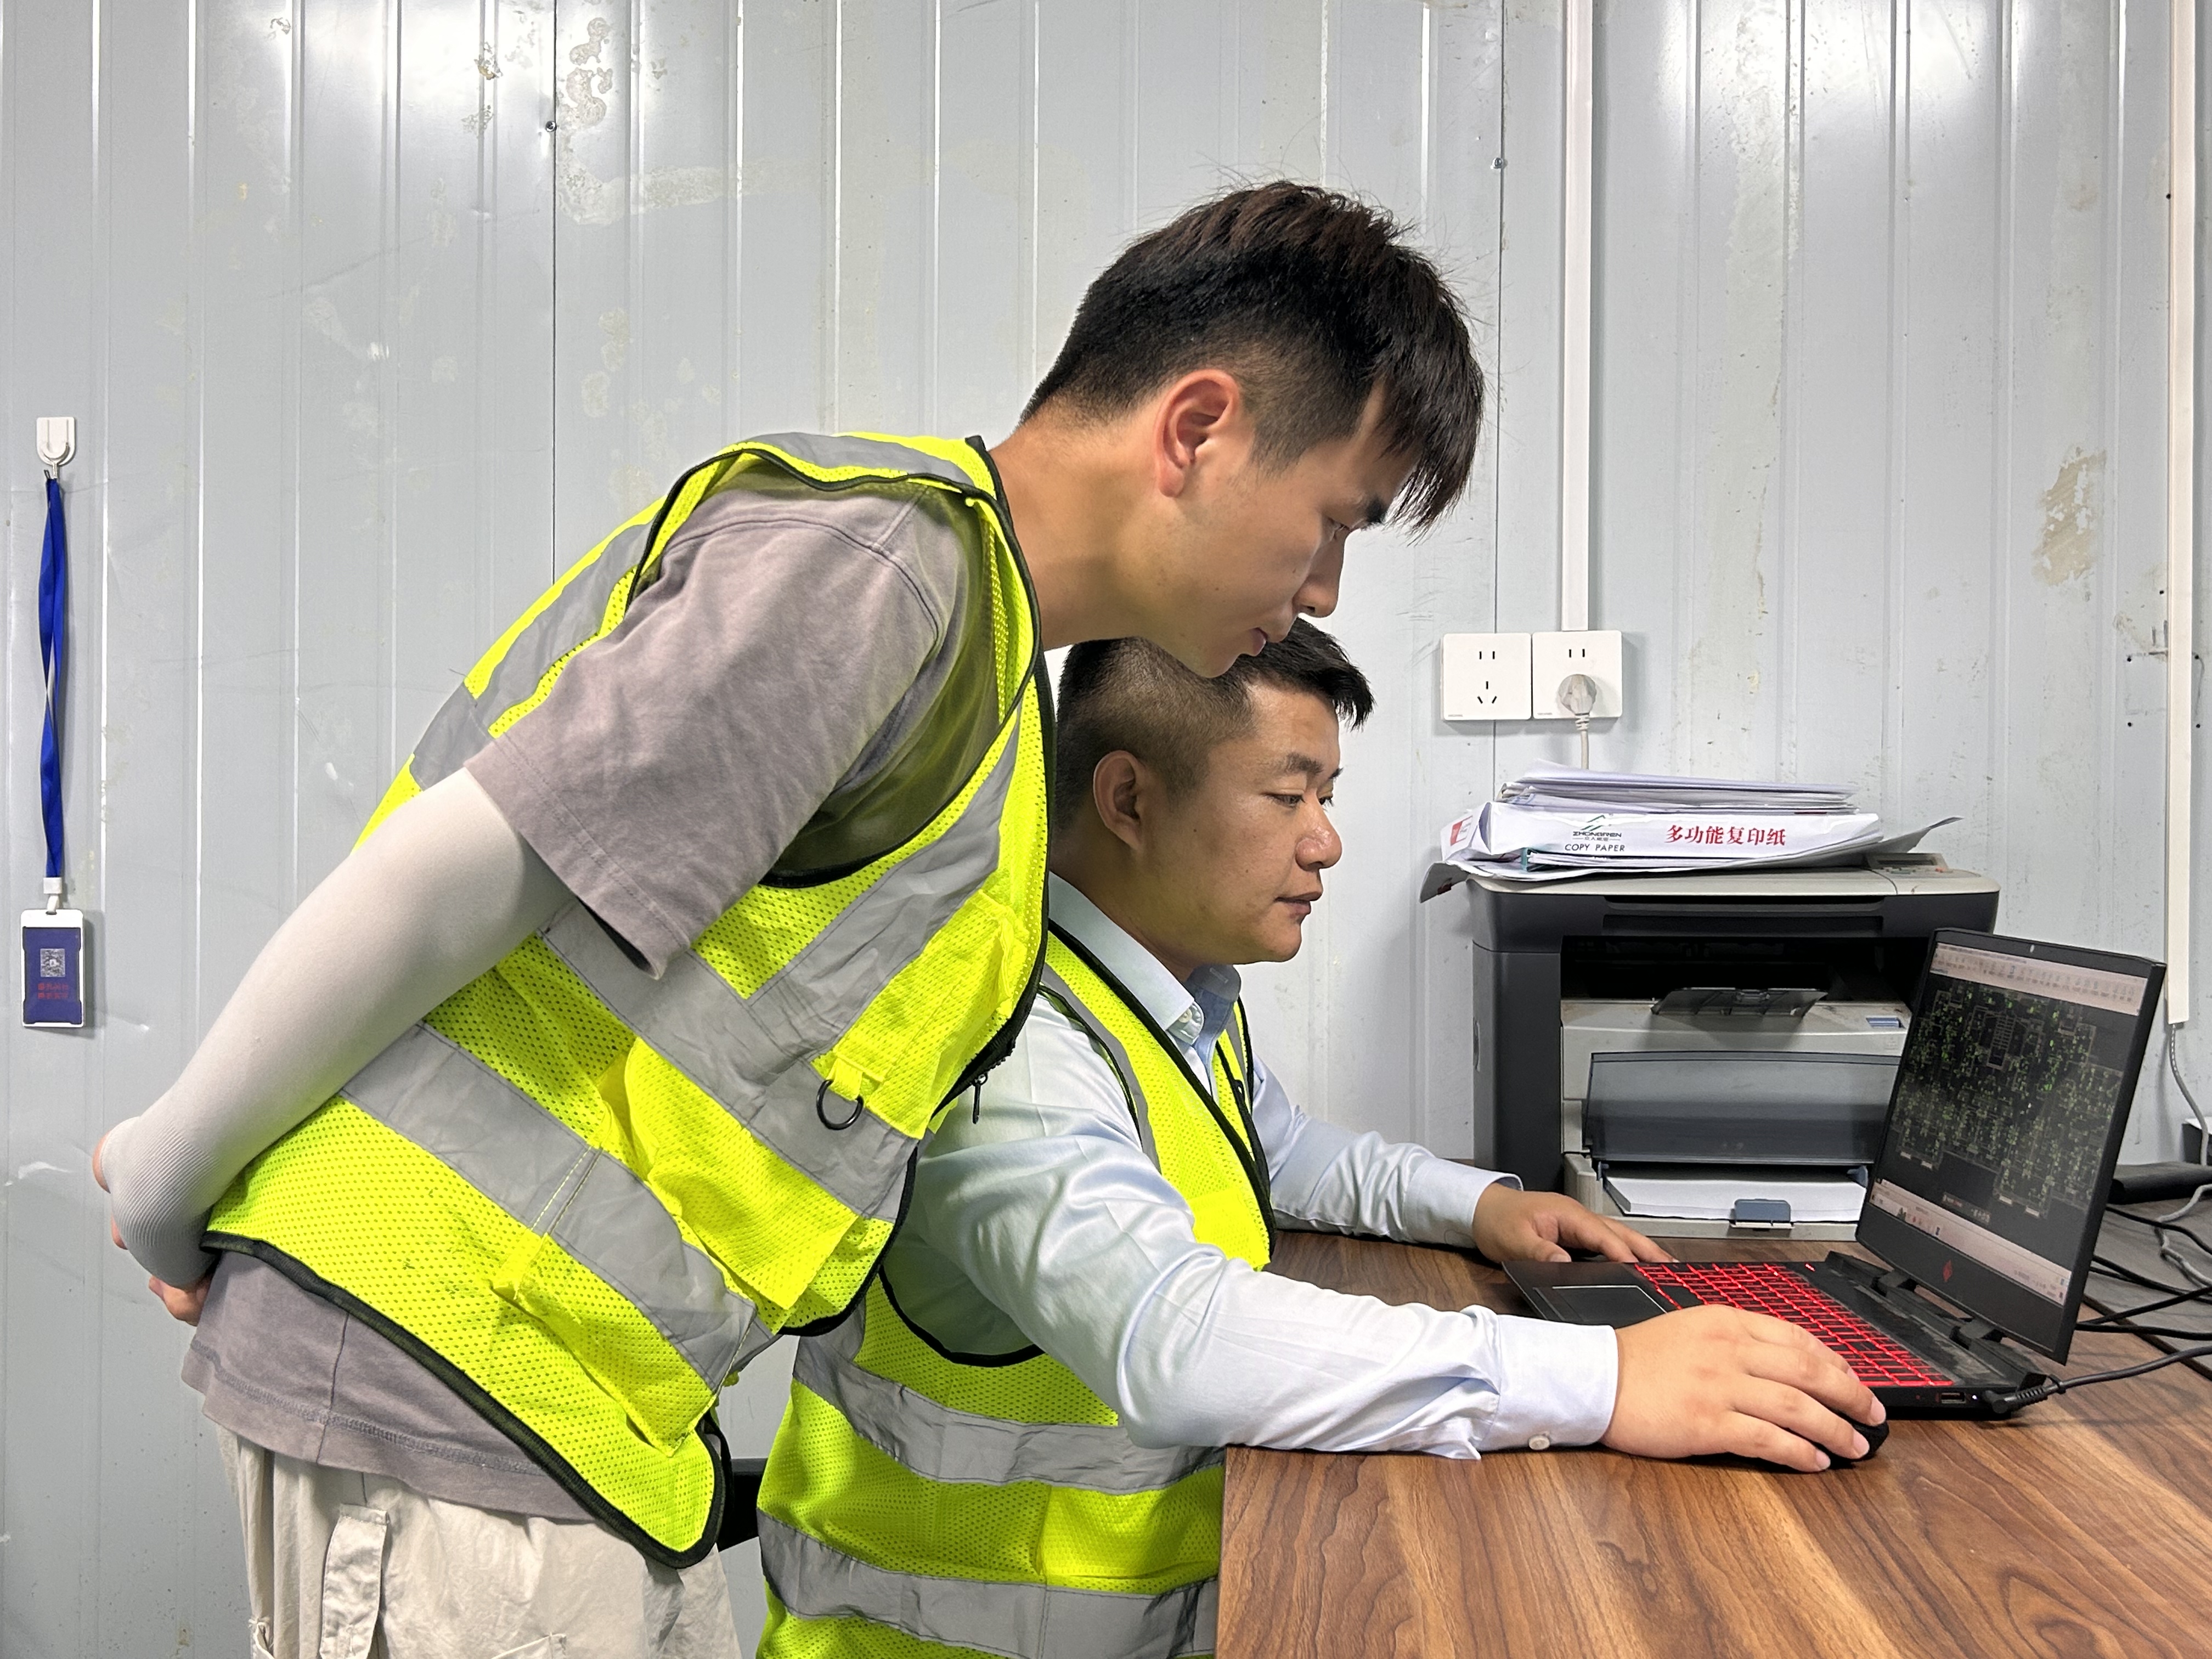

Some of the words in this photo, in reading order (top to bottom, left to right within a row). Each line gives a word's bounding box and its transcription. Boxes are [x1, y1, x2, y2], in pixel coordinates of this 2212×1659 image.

[1664, 825, 1786, 846] 多功能复印纸
